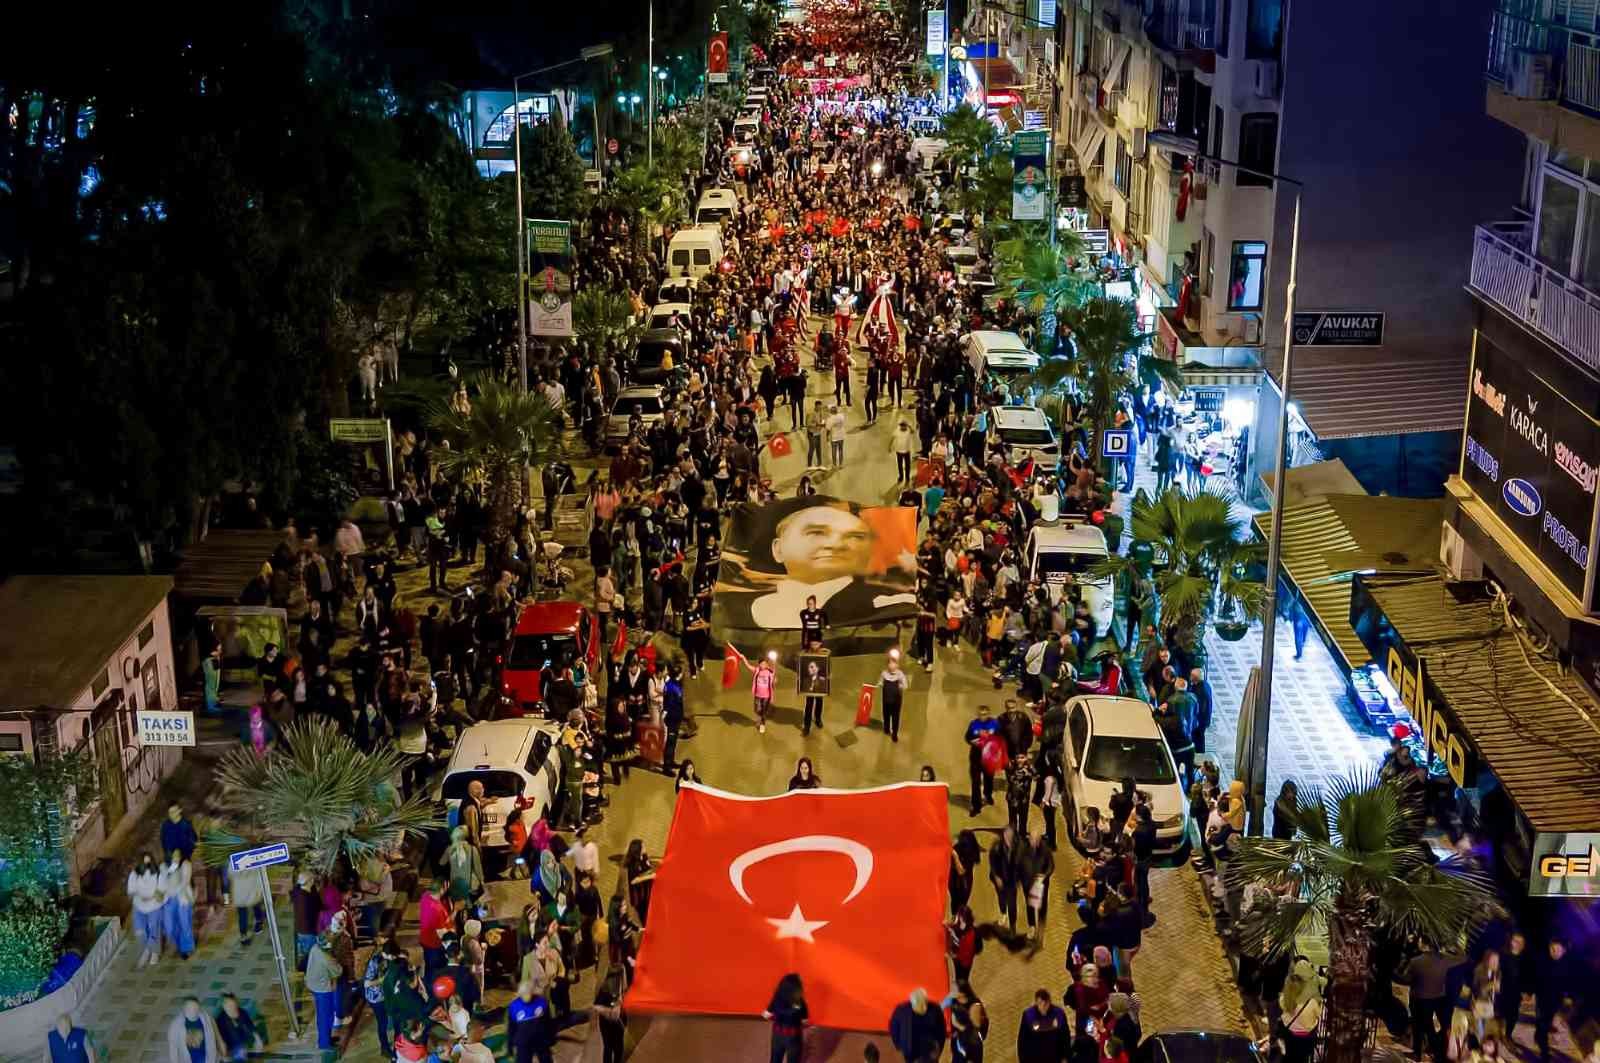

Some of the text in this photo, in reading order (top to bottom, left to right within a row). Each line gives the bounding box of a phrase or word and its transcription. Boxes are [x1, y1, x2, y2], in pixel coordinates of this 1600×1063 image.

[1323, 317, 1378, 328] AVUKAT
[1510, 405, 1547, 456] KARACA
[1112, 437, 1123, 450] D
[1507, 480, 1536, 514] SAMSUNG
[142, 716, 188, 730] TAKSİ
[144, 732, 161, 742] 313
